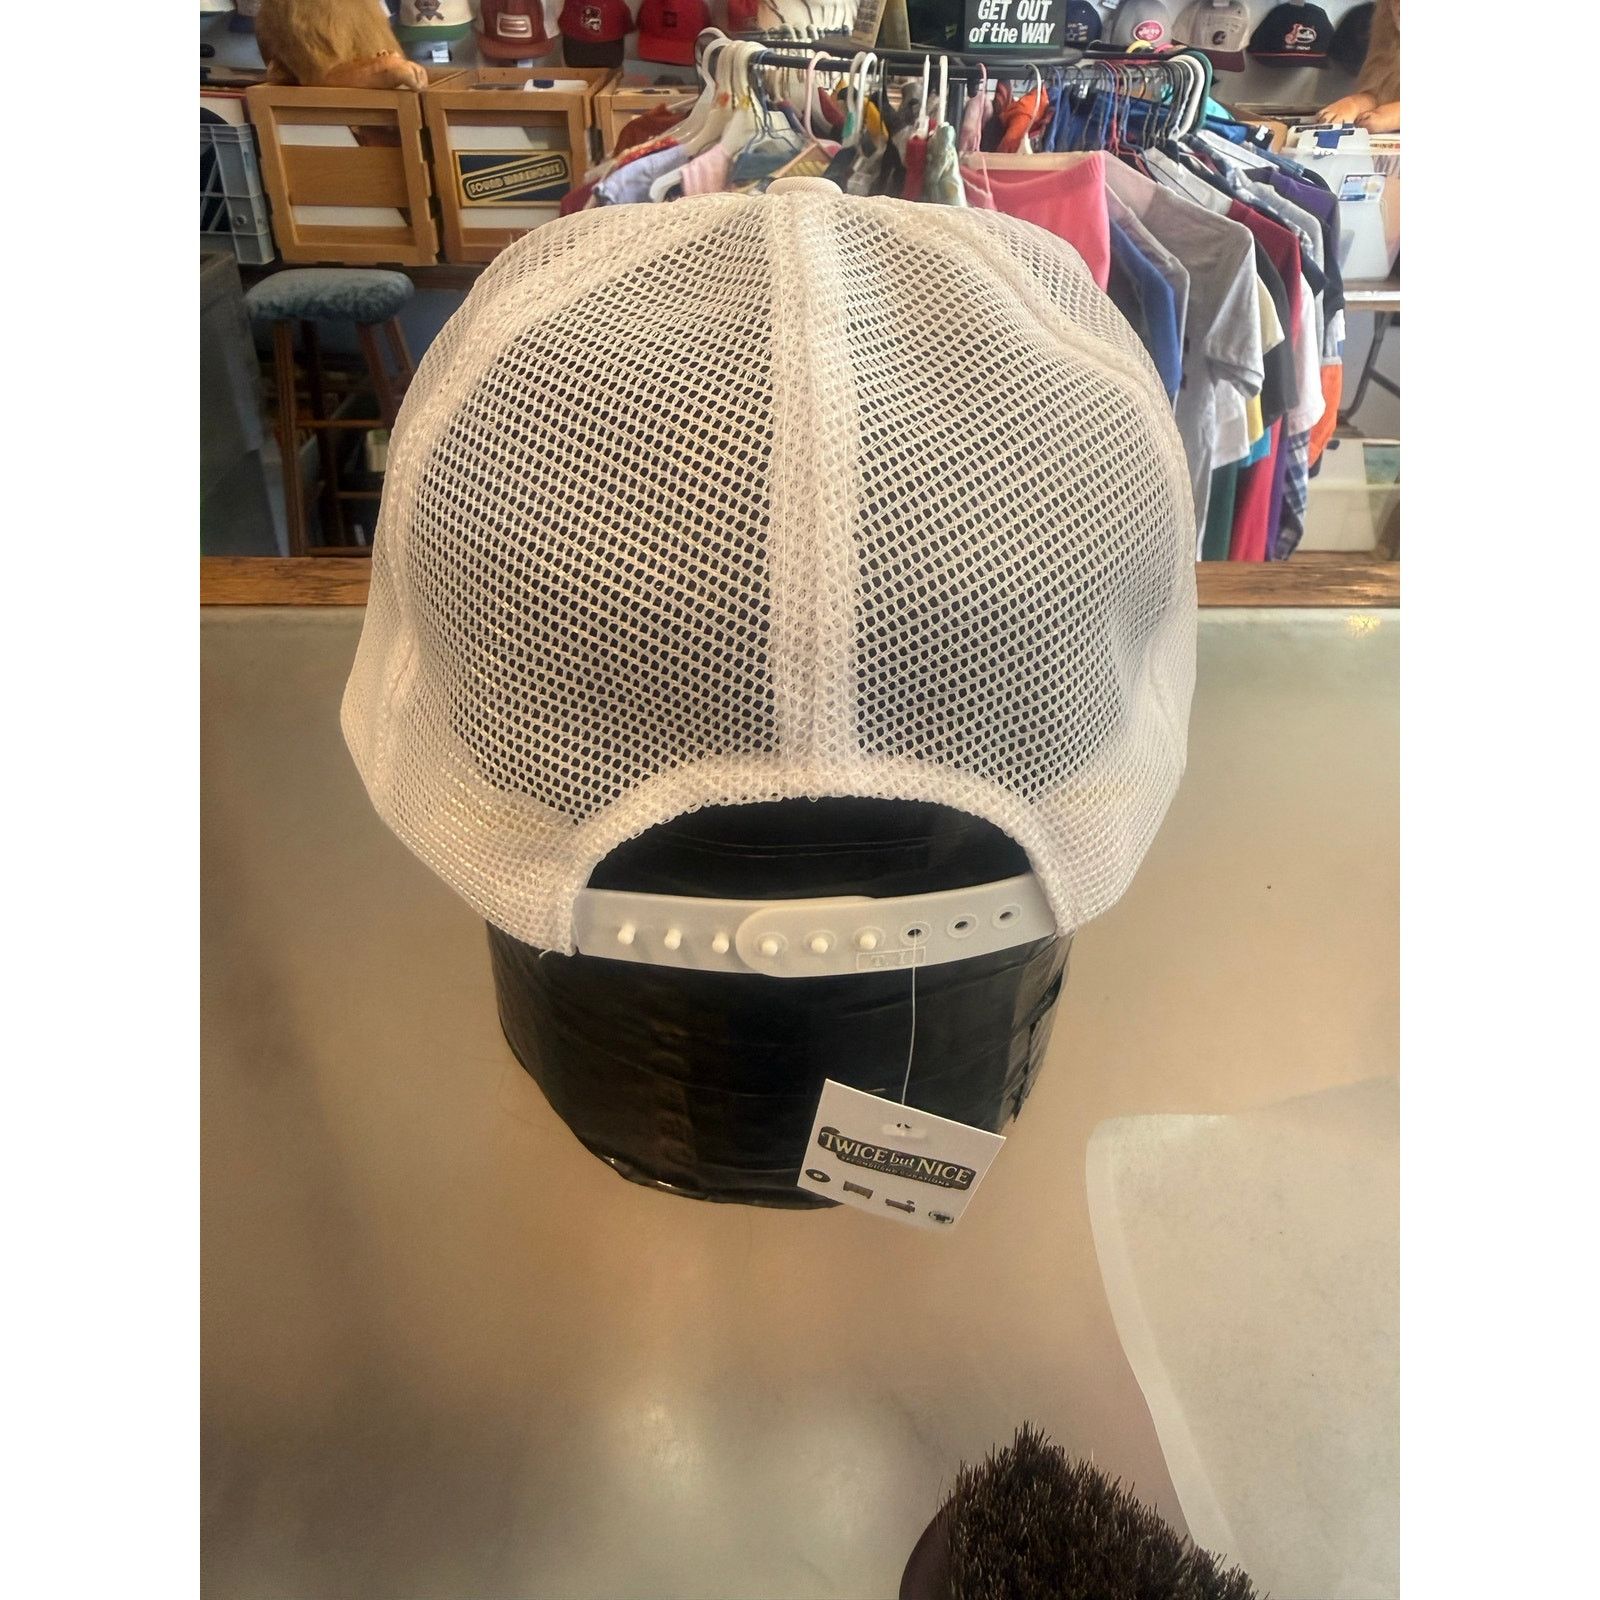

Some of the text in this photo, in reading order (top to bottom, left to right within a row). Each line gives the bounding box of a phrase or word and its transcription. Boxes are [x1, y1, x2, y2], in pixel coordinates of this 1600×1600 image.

[978, 0, 1052, 21] GET OUT
[969, 22, 991, 43] of
[990, 22, 1018, 43] the
[1021, 22, 1056, 44] WAY
[821, 1131, 890, 1164] TWICE
[890, 1152, 915, 1167] but
[916, 1157, 972, 1185] NICE
